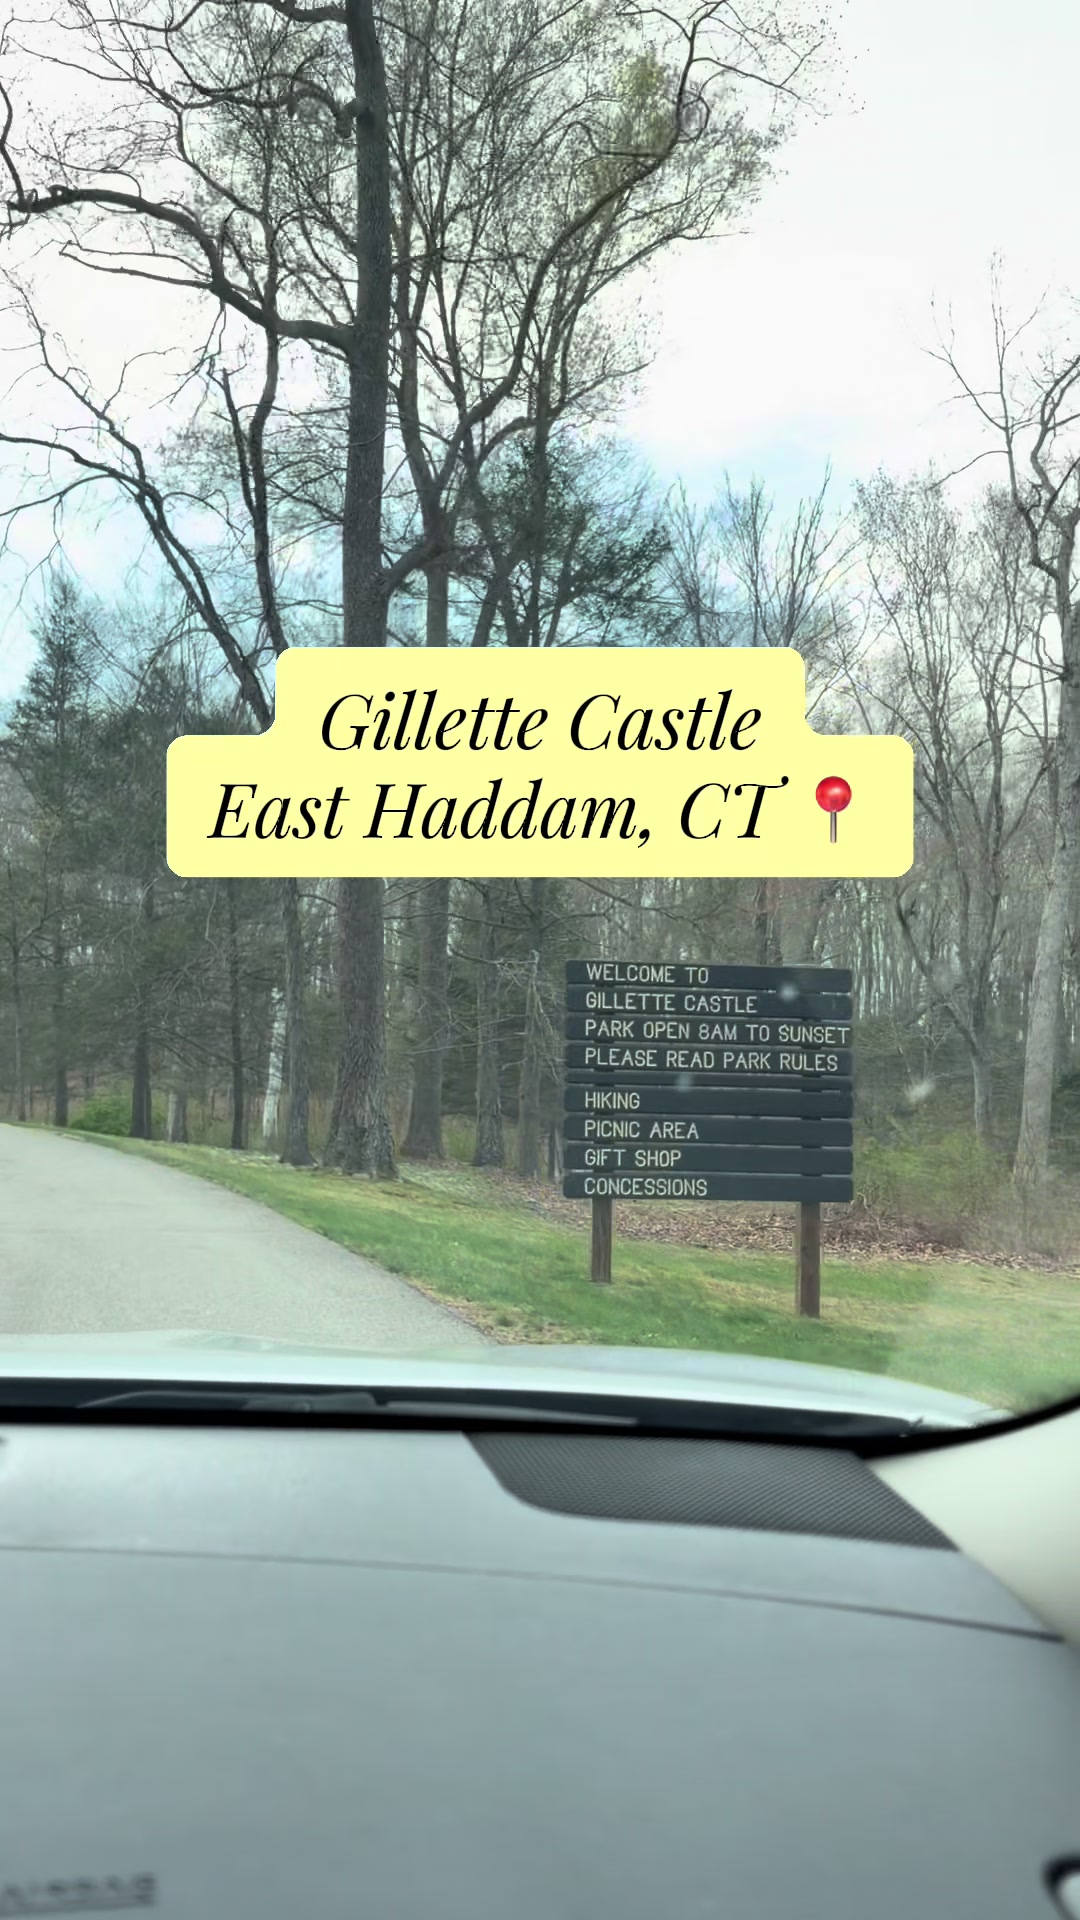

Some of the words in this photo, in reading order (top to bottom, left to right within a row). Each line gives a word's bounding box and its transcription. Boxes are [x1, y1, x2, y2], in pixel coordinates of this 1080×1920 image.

[586, 963, 676, 984] WELCOME
[684, 966, 709, 984] TO
[585, 991, 676, 1012] GILLETTE
[684, 995, 758, 1014] CASTLE
[585, 1019, 635, 1038] PARK
[643, 1021, 690, 1040] OPEN
[698, 1024, 738, 1041] 8AM
[745, 1024, 770, 1042] TO
[778, 1024, 850, 1045] SUNSET
[585, 1048, 658, 1067] PLEASE
[666, 1051, 715, 1069] READ
[723, 1052, 771, 1070] PARK
[779, 1053, 838, 1072] RULES
[584, 1091, 641, 1110] HIKING
[584, 1120, 641, 1139] PICNIC
[649, 1122, 700, 1140] AREA
[584, 1149, 627, 1167] GIFT
[634, 1150, 682, 1168] SHOP
[584, 1177, 708, 1197] CONCESSIONS
